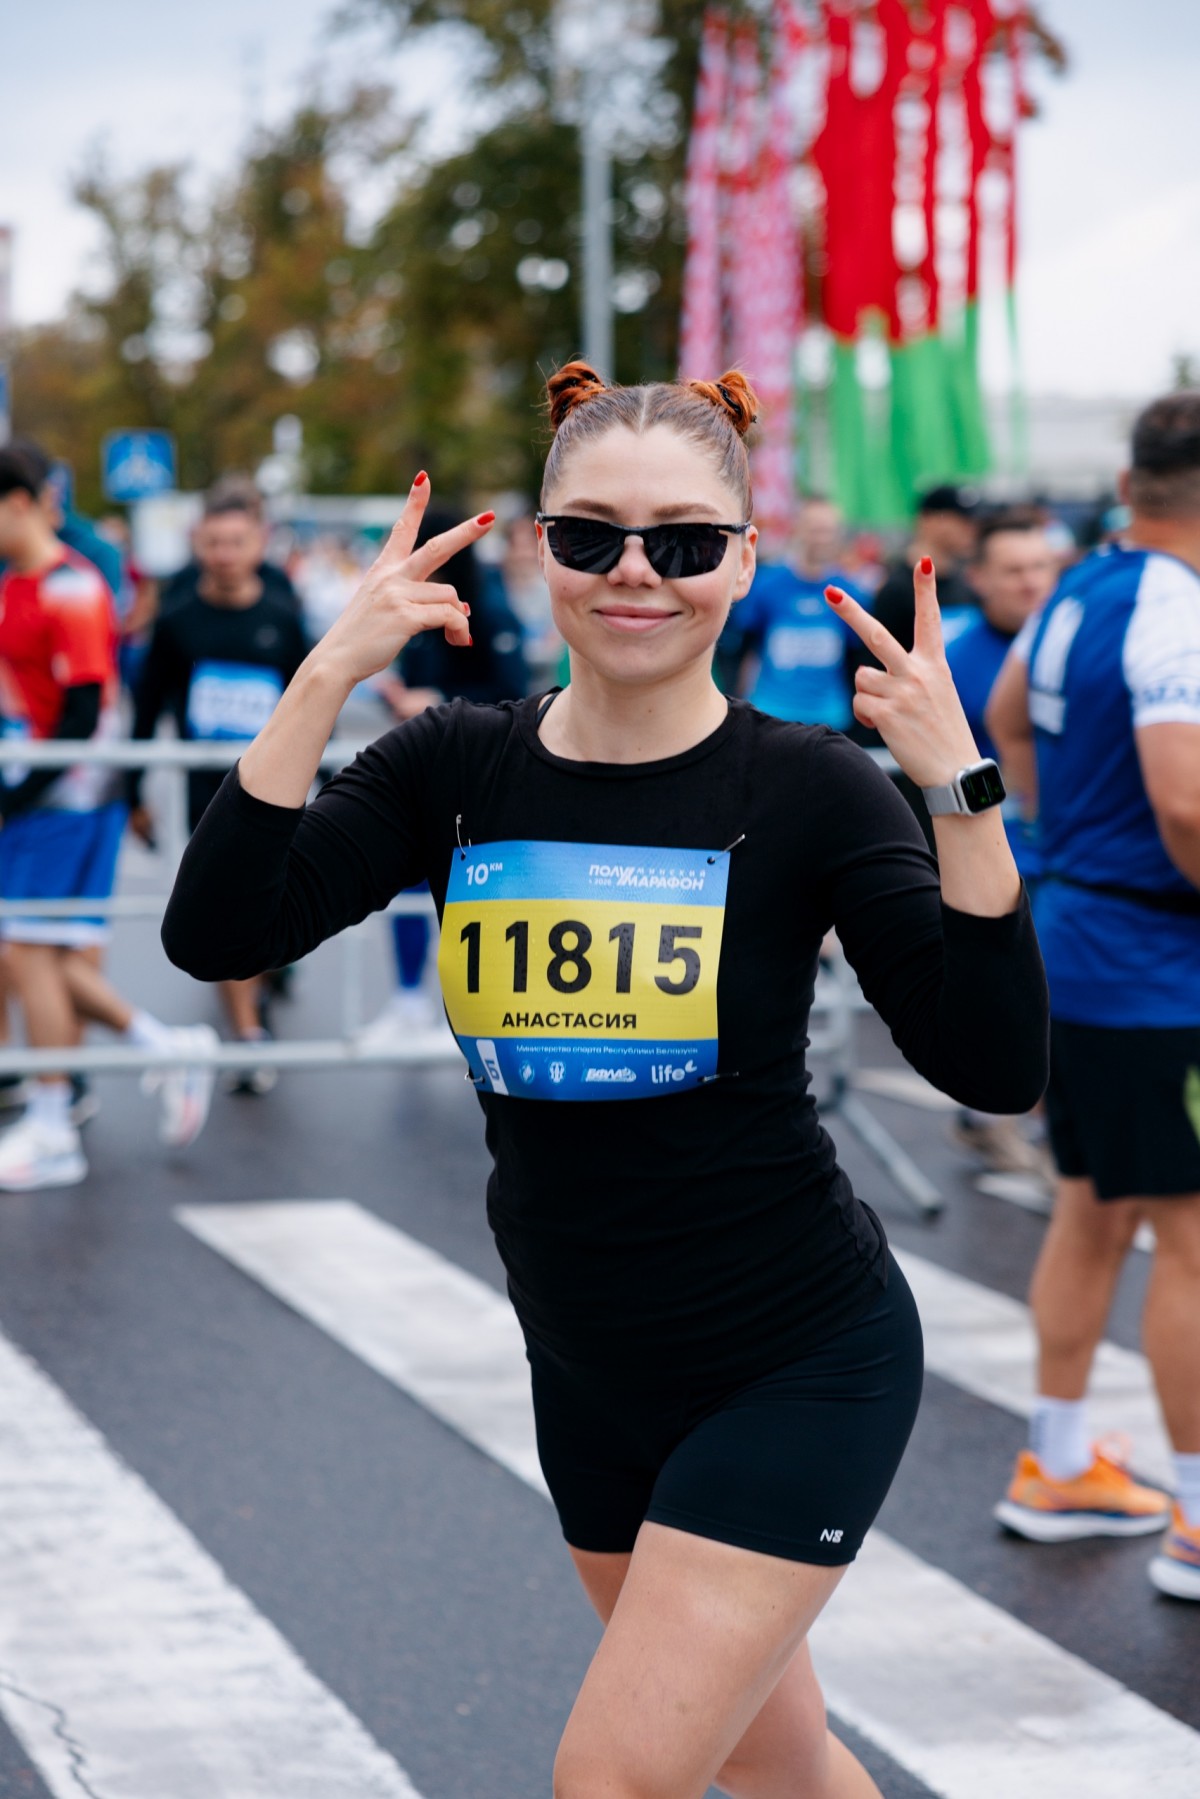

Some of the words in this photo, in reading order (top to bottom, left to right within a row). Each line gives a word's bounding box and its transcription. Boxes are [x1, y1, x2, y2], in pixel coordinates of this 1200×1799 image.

[466, 863, 489, 886] 10
[589, 864, 635, 878] ПОЛУ
[618, 874, 704, 891] МАРАФОН
[460, 919, 703, 996] 11815
[501, 1012, 637, 1029] АНАСТАСИЯ
